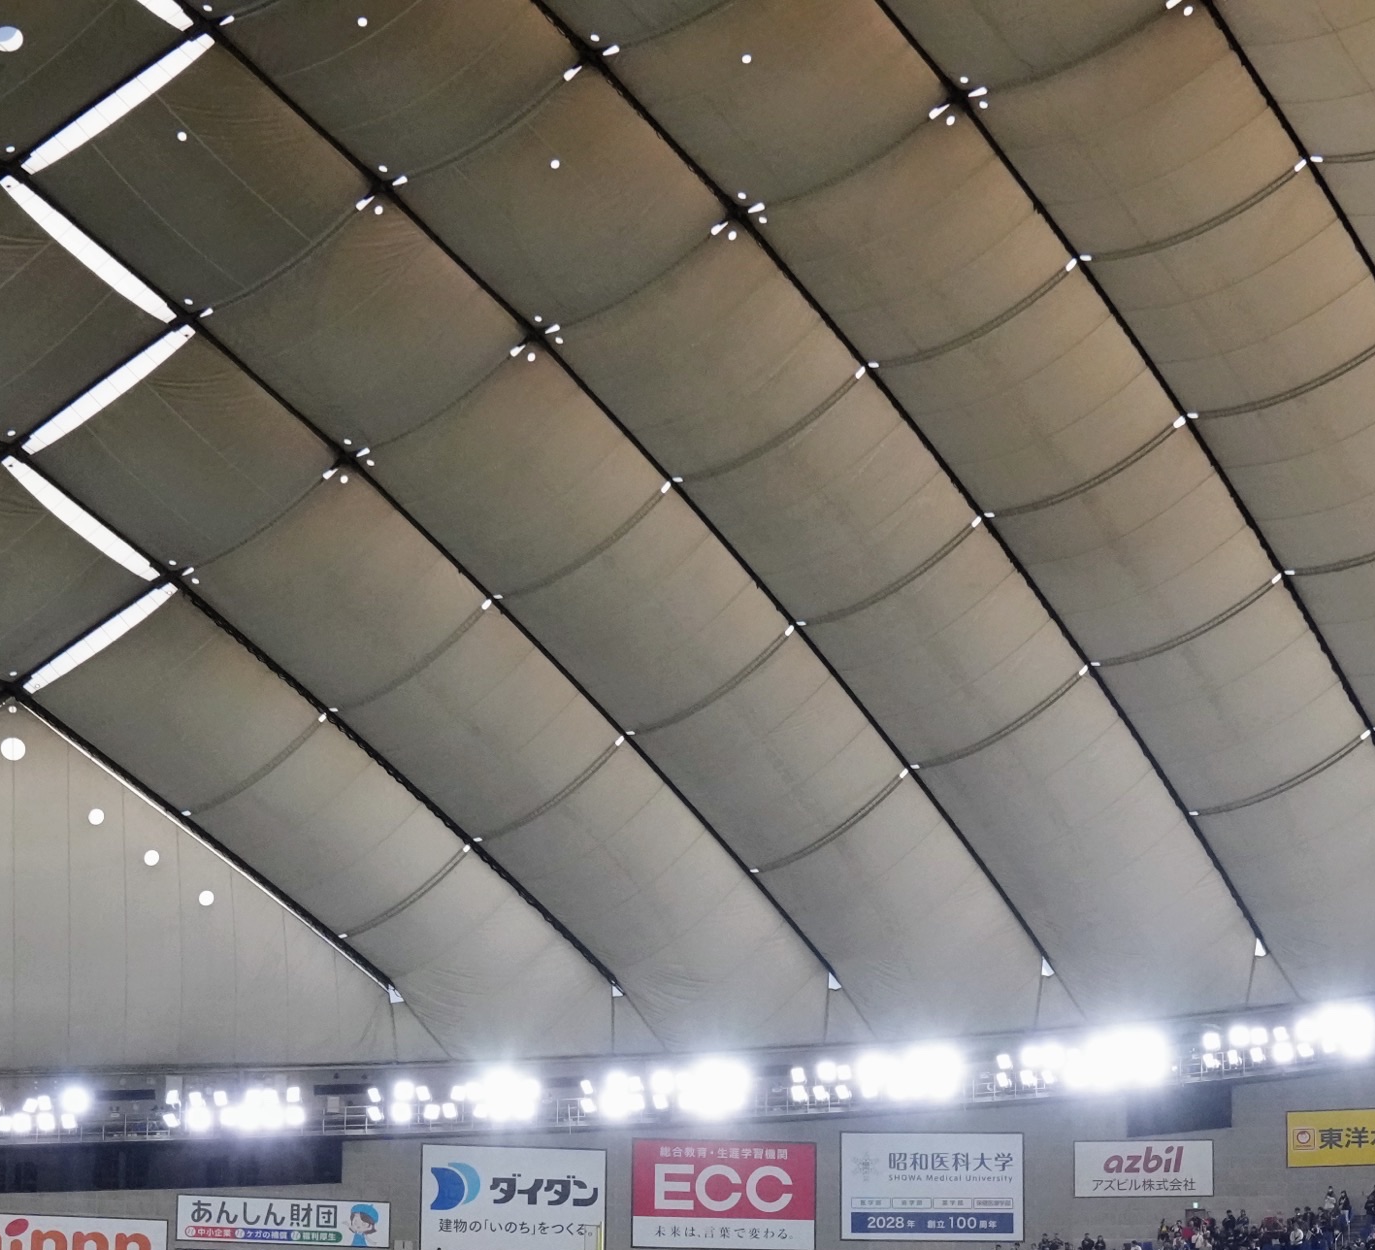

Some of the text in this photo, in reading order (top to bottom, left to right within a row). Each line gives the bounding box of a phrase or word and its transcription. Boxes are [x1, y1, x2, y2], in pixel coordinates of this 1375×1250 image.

[660, 1145, 788, 1160] 総合教育・生涯学習機関
[1103, 1146, 1184, 1174] azbil
[888, 1152, 1014, 1172] 昭和医科大学
[888, 1174, 1013, 1184] SHOWA Medical University
[1092, 1177, 1196, 1191] アズビル株式会社
[489, 1173, 599, 1207] ダイダン
[654, 1163, 793, 1213] ECC
[191, 1199, 338, 1228] あんしん財団
[867, 1217, 915, 1229] 2028 年
[949, 1216, 976, 1229] 100
[979, 1220, 997, 1229] 周年
